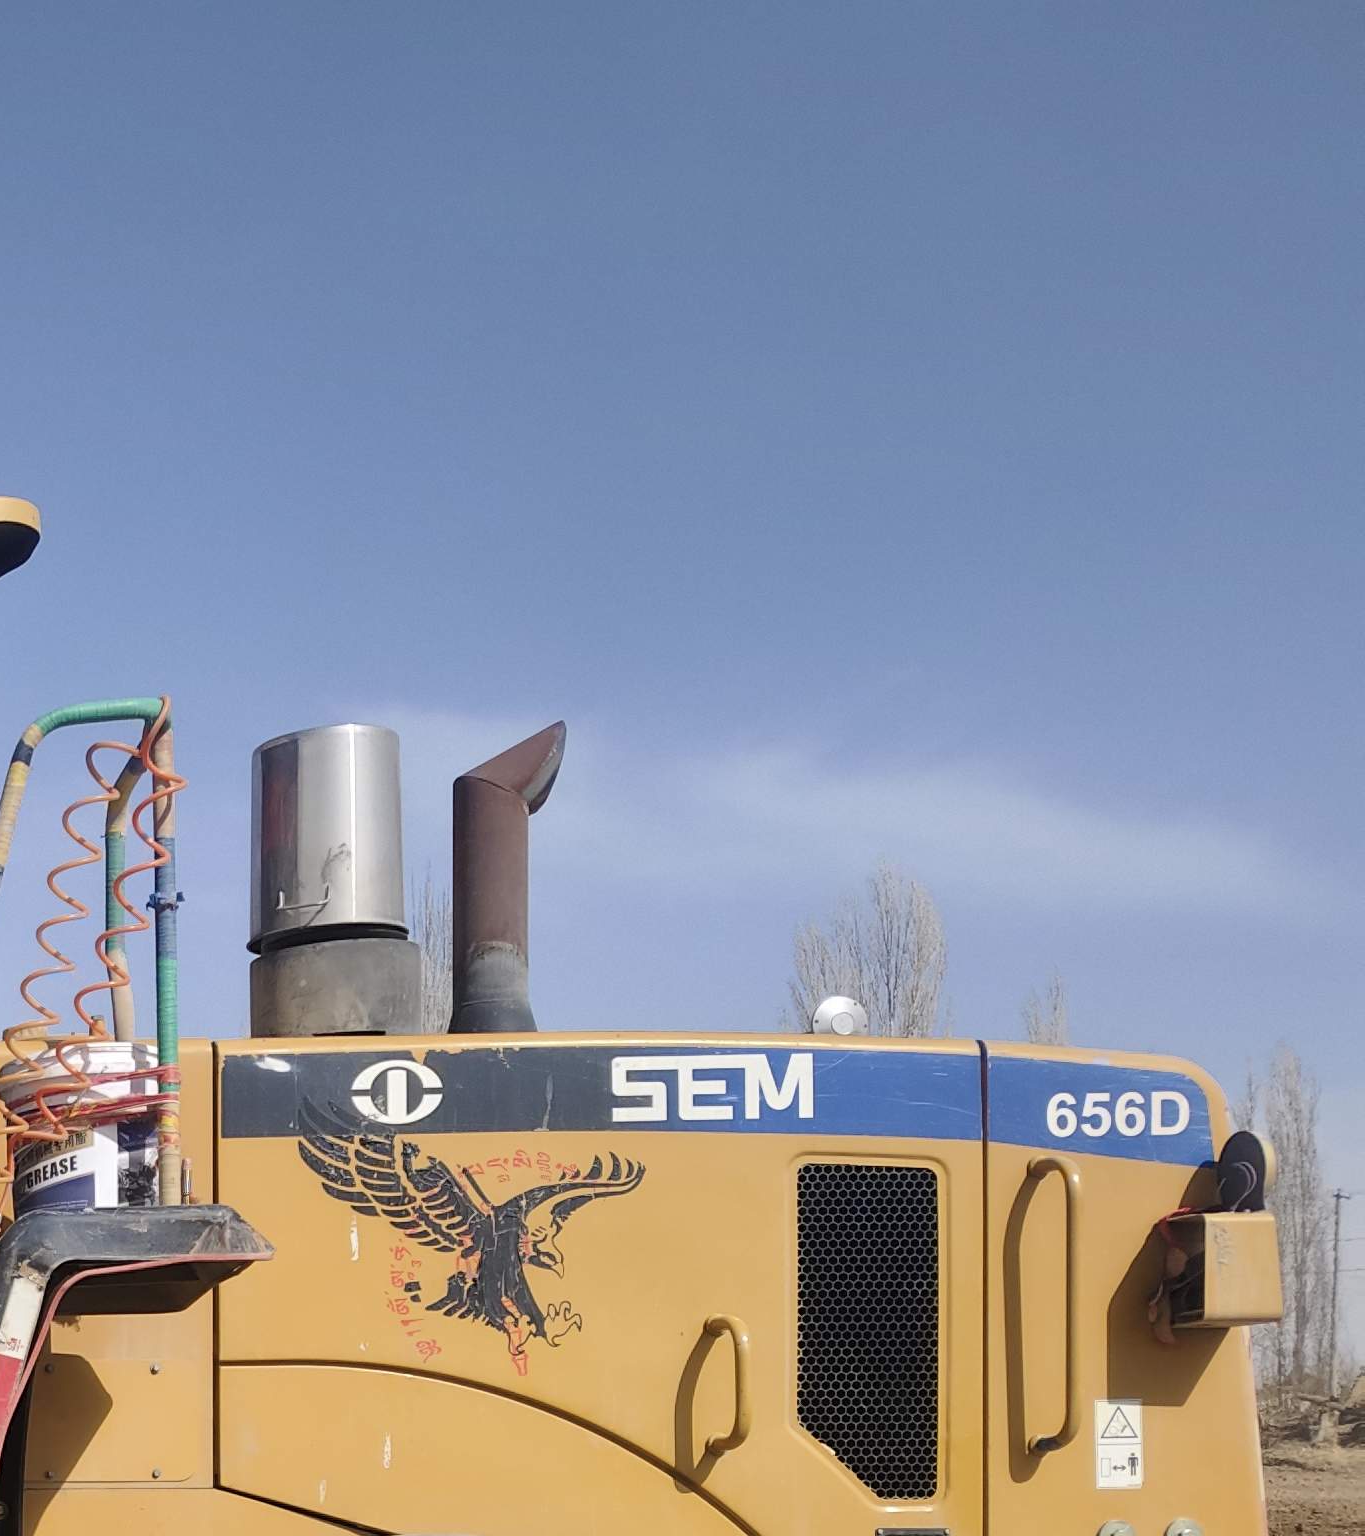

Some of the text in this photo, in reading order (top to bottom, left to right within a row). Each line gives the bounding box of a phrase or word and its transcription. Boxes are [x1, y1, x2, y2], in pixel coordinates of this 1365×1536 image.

[611, 1053, 813, 1122] SEM
[1046, 1091, 1190, 1138] 656D
[26, 1155, 78, 1190] GREASE
